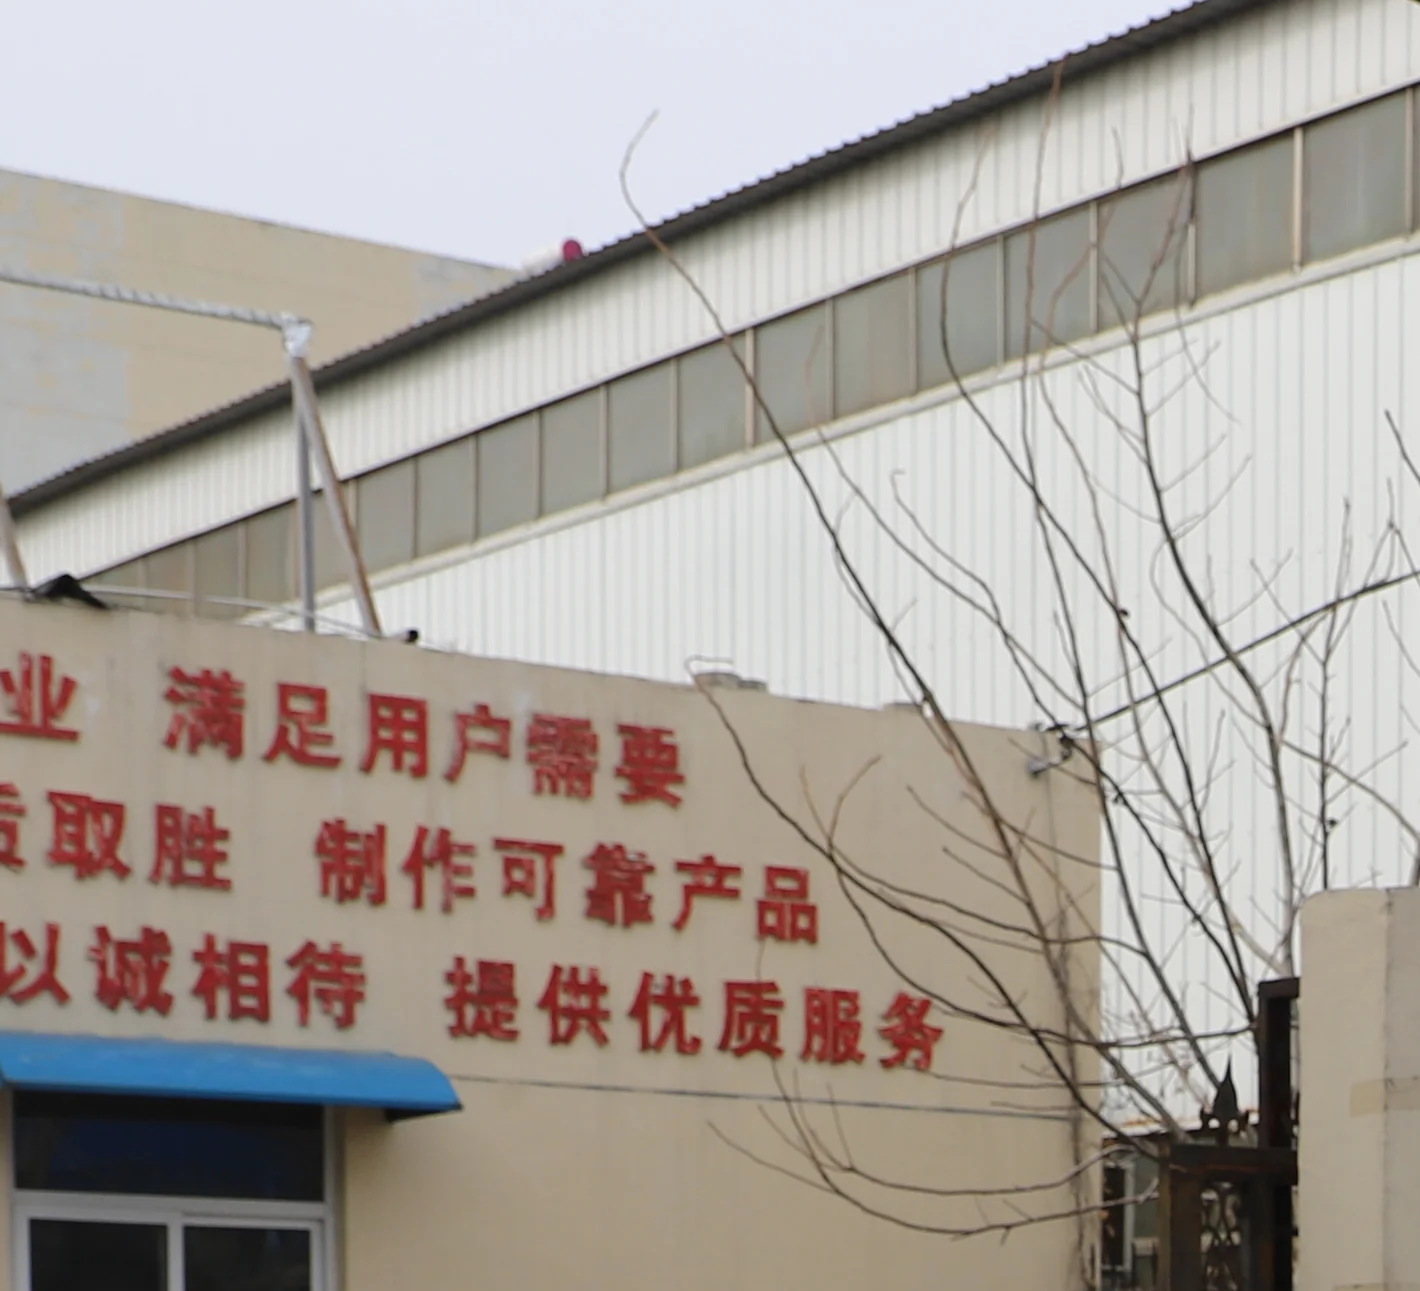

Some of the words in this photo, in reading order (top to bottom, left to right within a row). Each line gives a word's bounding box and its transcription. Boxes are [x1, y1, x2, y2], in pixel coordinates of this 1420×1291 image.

[0, 651, 79, 741] 业
[163, 665, 686, 808] 满足用户需要
[314, 817, 819, 943] 制作可靠产品
[0, 921, 367, 1028] 以诚相待
[445, 956, 943, 1070] 提供优质服务
